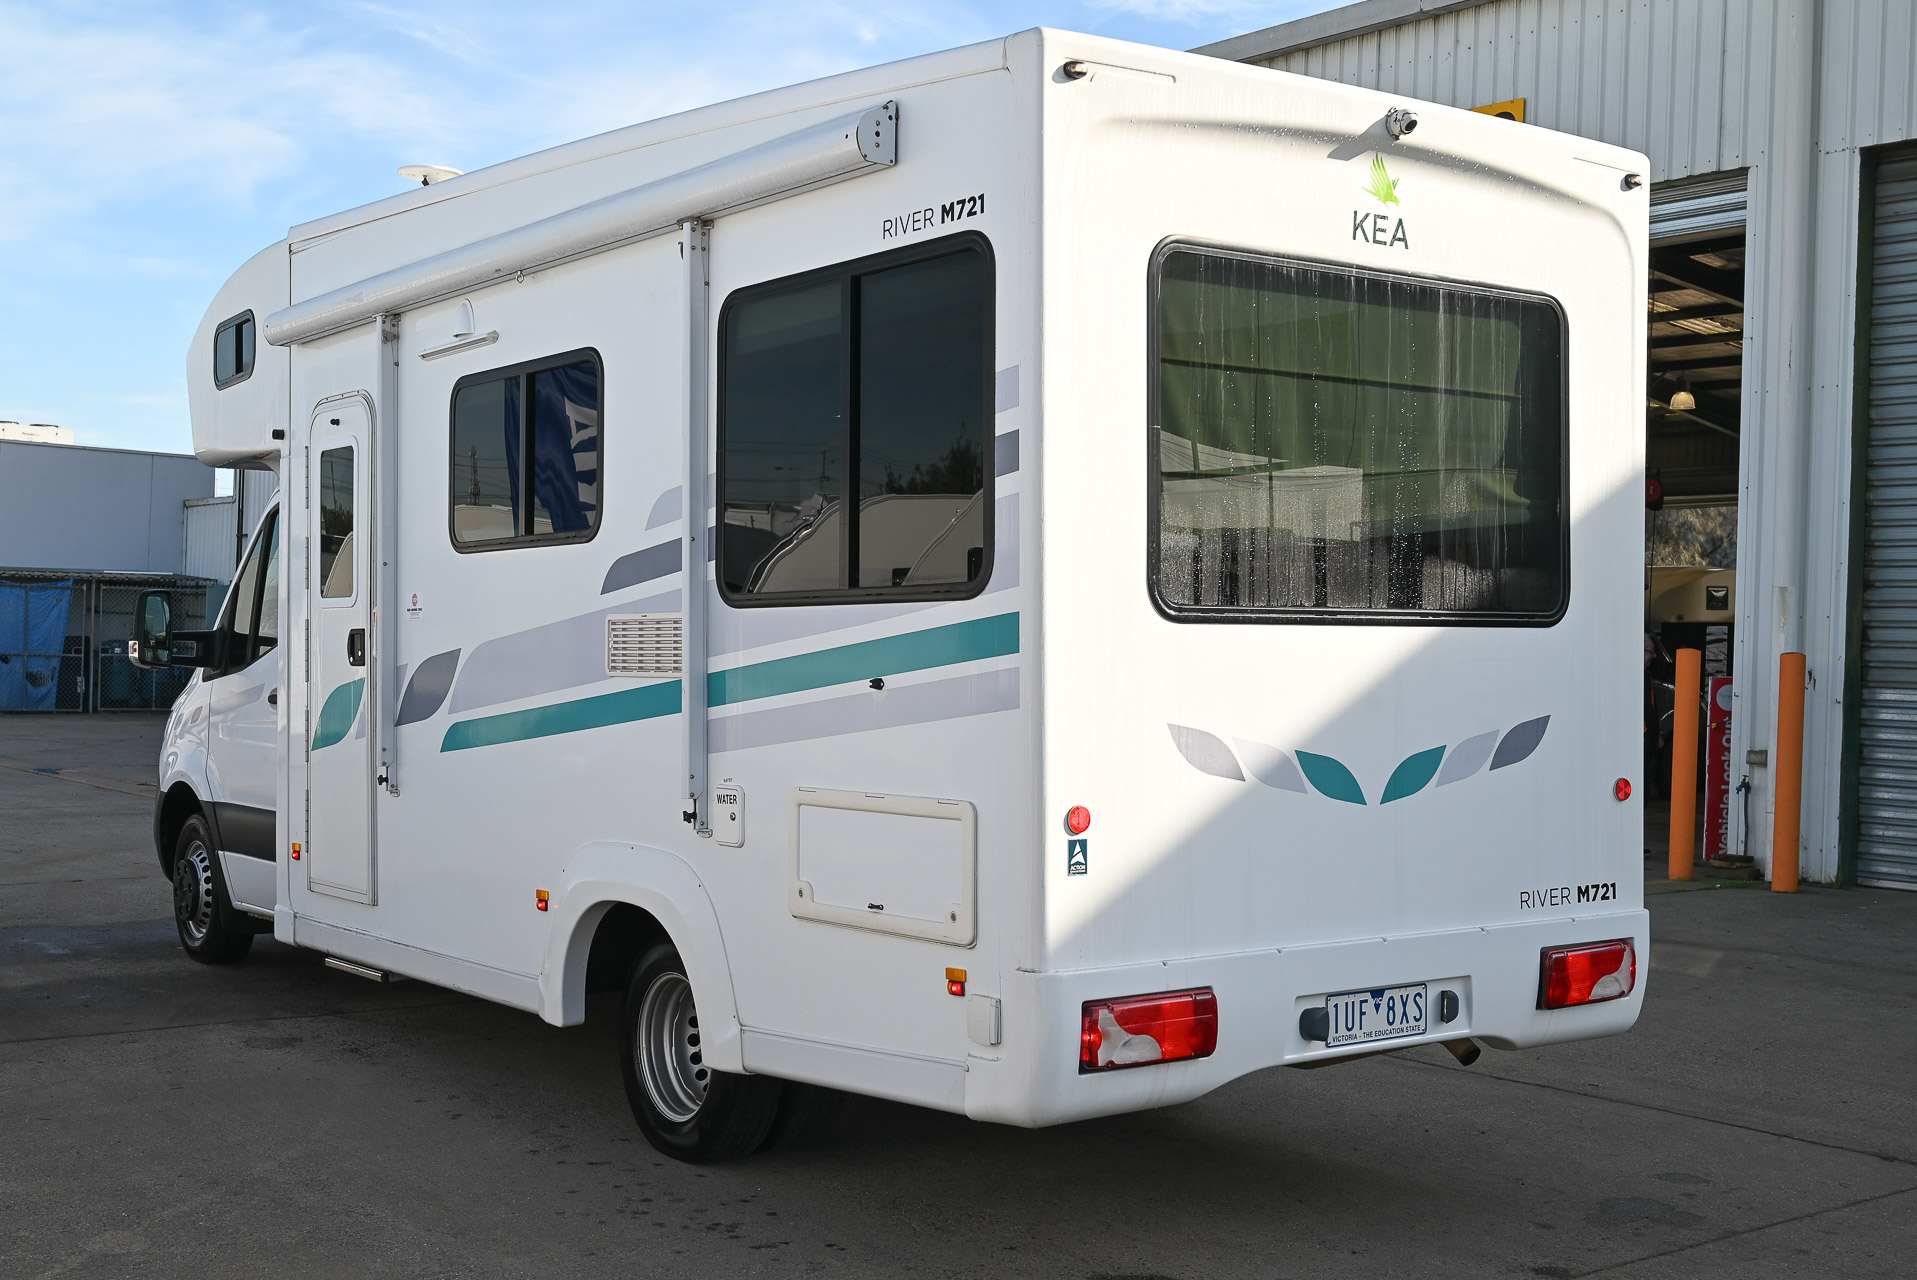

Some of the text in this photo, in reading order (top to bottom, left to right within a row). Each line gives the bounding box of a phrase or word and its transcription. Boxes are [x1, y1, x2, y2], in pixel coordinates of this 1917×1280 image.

[882, 193, 985, 240] RIVER M721
[1352, 210, 1409, 250] KEA
[716, 793, 738, 805] WATER
[1520, 882, 1617, 909] RIVER M721
[1333, 992, 1423, 1034] 1UF 8XS
[1332, 1034, 1358, 1043] VICTORIA
[1363, 1031, 1373, 1039] THE
[1374, 1027, 1405, 1037] EDUCATION
[1405, 1024, 1421, 1033] STATE
